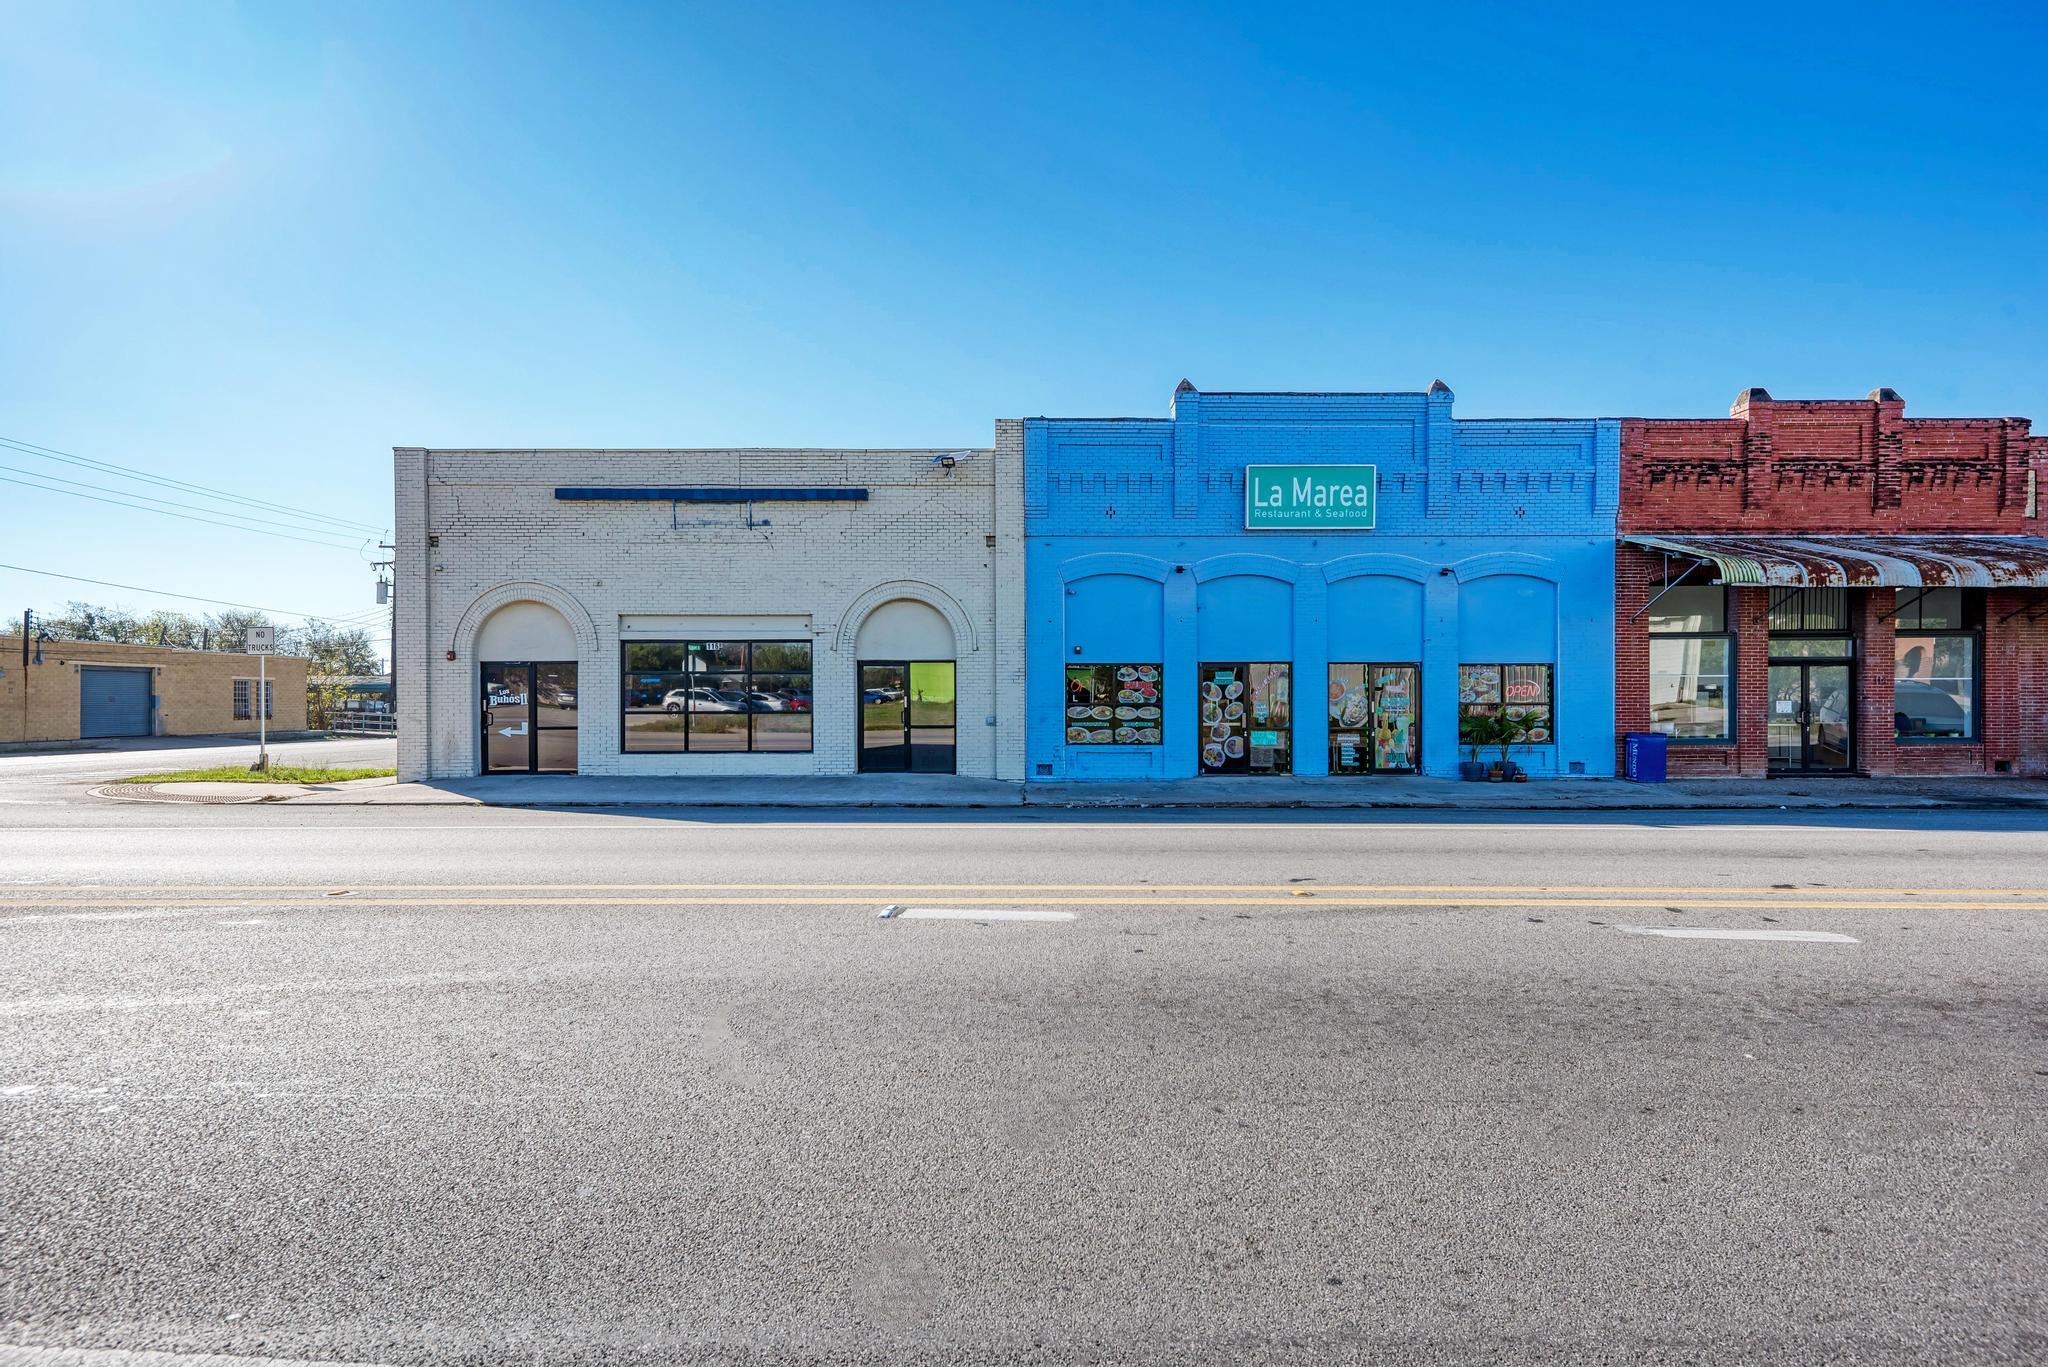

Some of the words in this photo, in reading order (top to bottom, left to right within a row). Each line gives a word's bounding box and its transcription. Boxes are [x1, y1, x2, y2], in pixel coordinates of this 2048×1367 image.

[1254, 477, 1282, 507] La
[1293, 477, 1367, 507] Marea
[1254, 508, 1311, 518] Restaurant
[1314, 508, 1322, 518] &
[1326, 508, 1367, 518] Seafood
[255, 631, 265, 639] NO
[248, 643, 274, 652] TRUCKS
[1505, 685, 1537, 697] OPEN
[489, 694, 520, 706] Buhos
[1631, 743, 1639, 778] MUNDO
